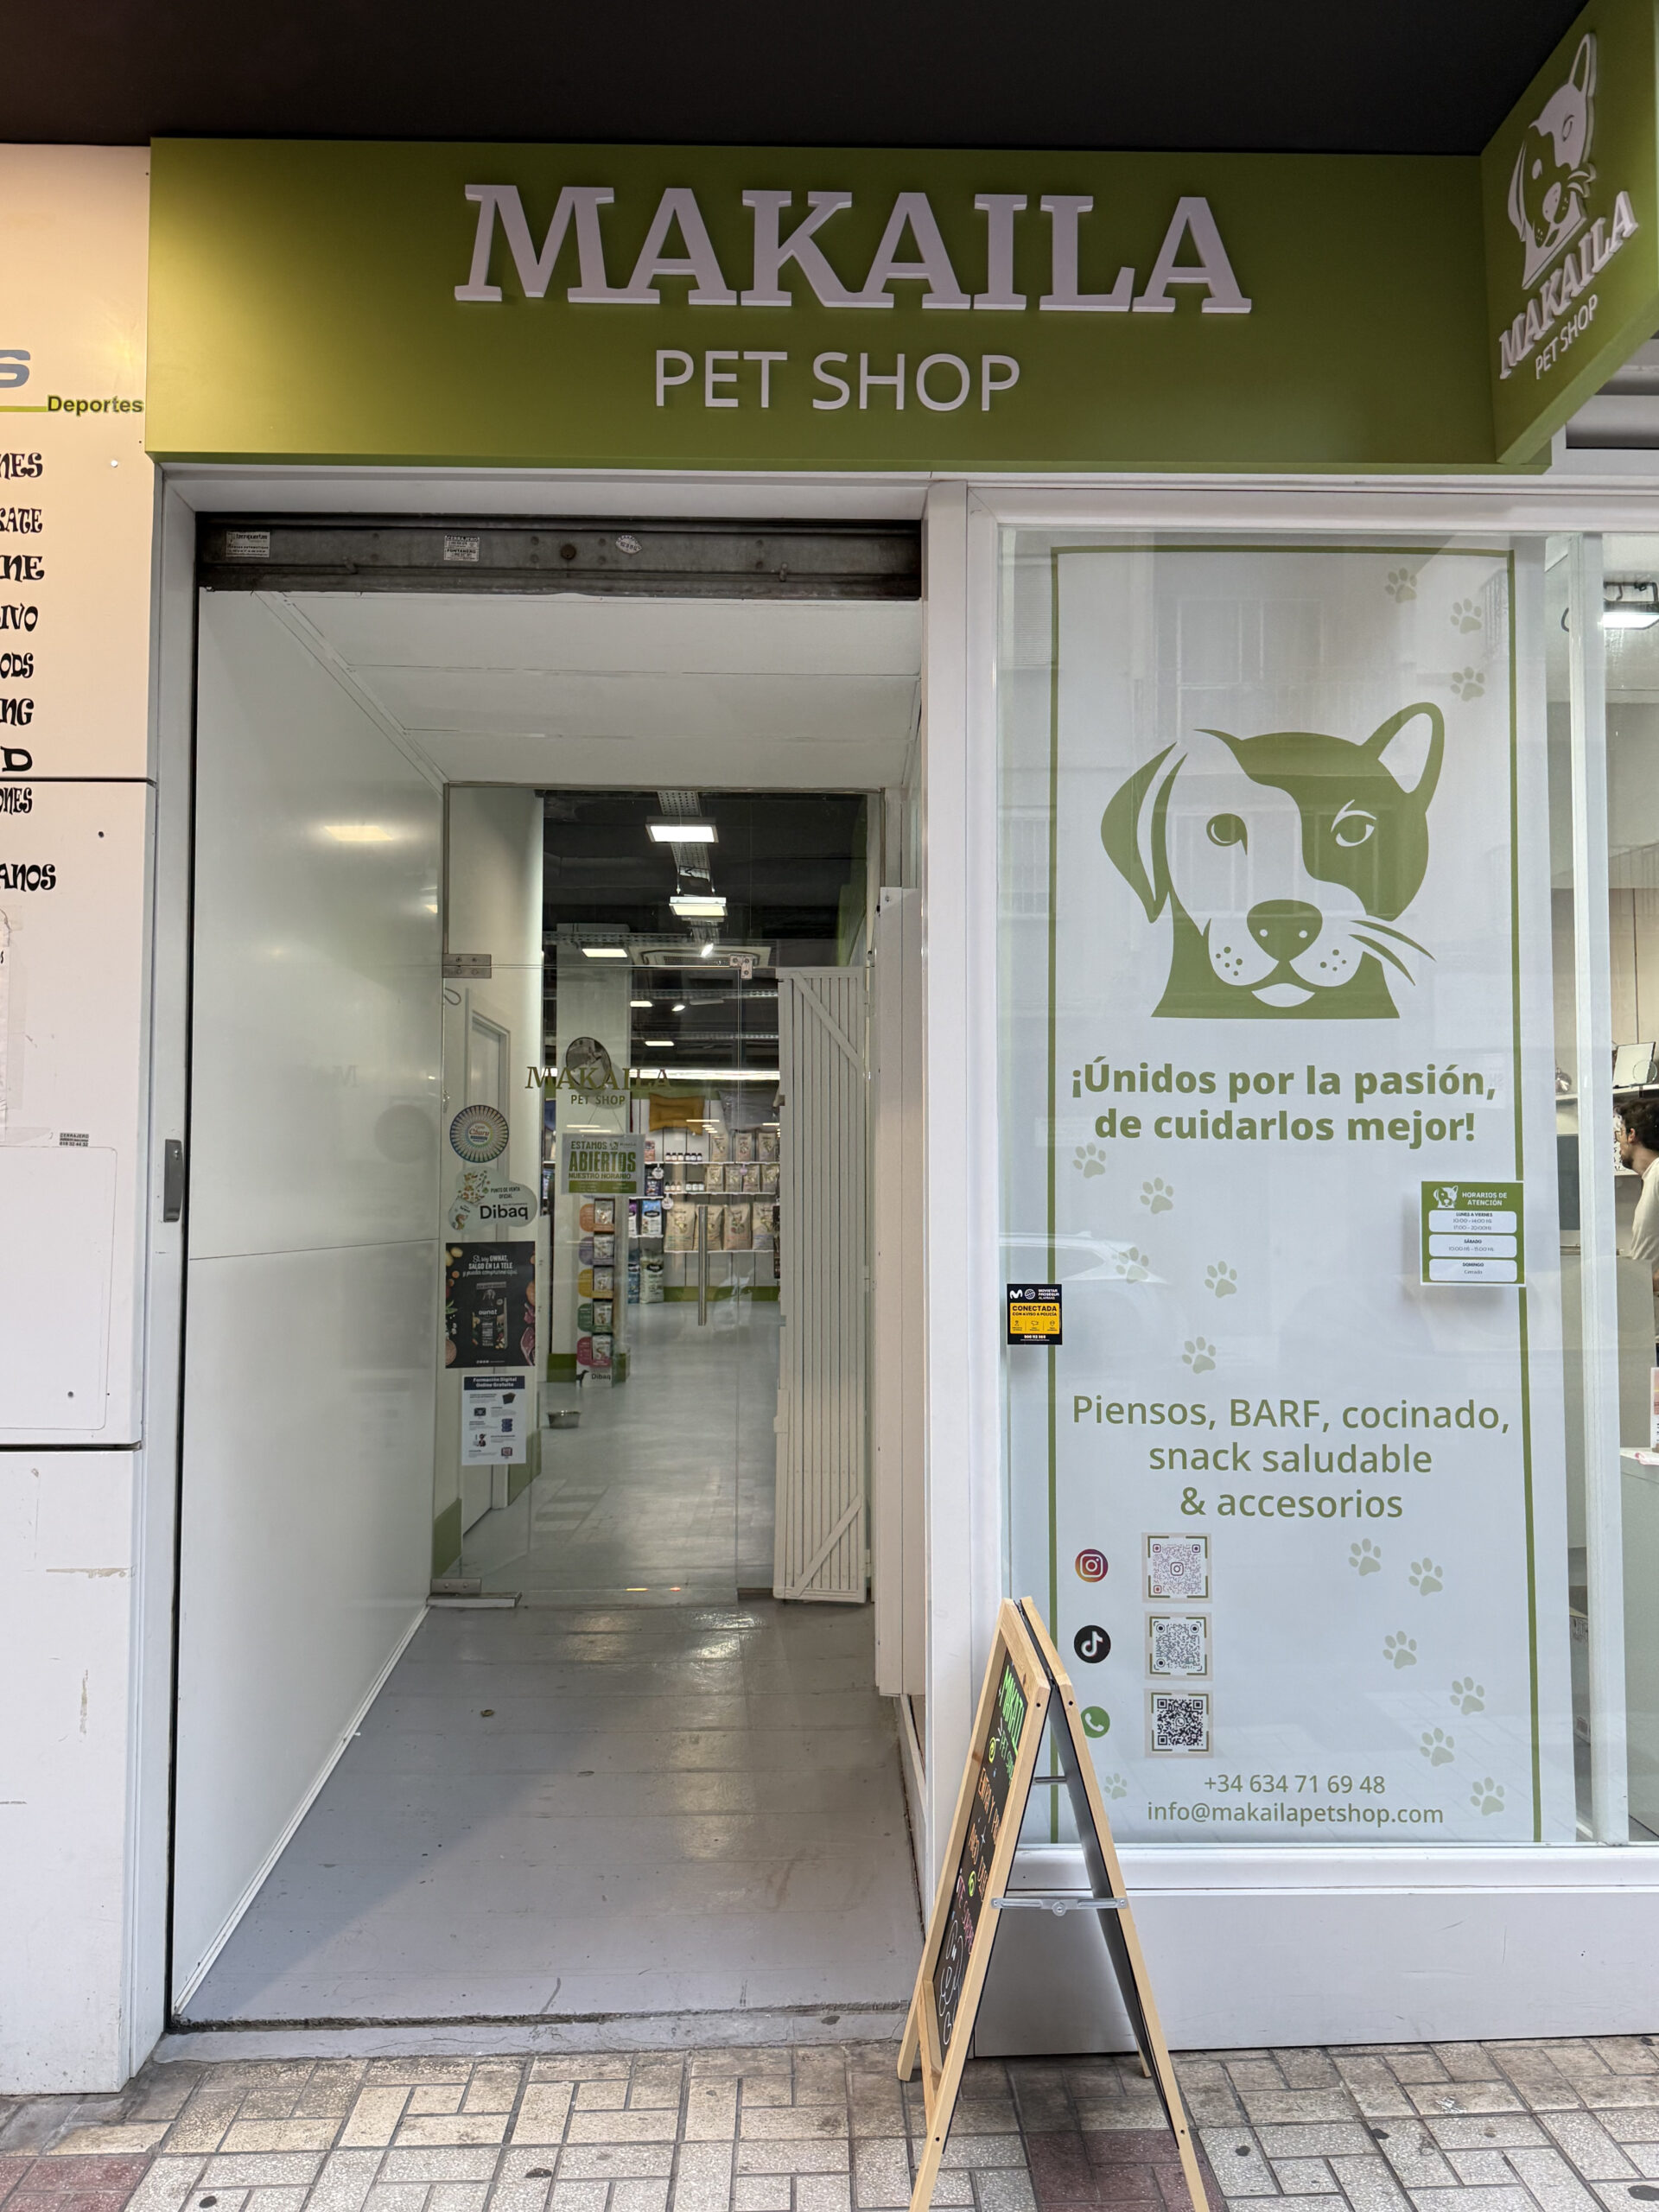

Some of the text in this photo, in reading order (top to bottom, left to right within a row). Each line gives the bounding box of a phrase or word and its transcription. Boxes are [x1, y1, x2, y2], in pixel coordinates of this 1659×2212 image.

[454, 184, 1252, 314] MAKAILA
[1499, 190, 1638, 380] MAKAILA
[1535, 294, 1598, 380] PET SHOP
[656, 350, 1020, 412] PET SHOP
[48, 395, 144, 416] Deportes
[524, 1066, 671, 1090] MAKAILA
[1072, 1056, 1496, 1103] ¡Únidos por la pasión,
[571, 1095, 626, 1105] PET SHOP
[1095, 1108, 1475, 1149] de cuidarlos mejor!
[571, 1141, 607, 1150] ESTAMOS
[569, 1151, 636, 1173] ABIERTOS
[480, 1205, 528, 1220] Dibaq
[1072, 1395, 1510, 1434] Piensos, BARF, cocinado,
[1148, 1441, 1432, 1473] snack saludable
[1179, 1486, 1404, 1518] & accesorios
[1204, 1774, 1386, 1794] +34 634 71 69 48
[1147, 1802, 1444, 1827] info@makailapetshop.com
